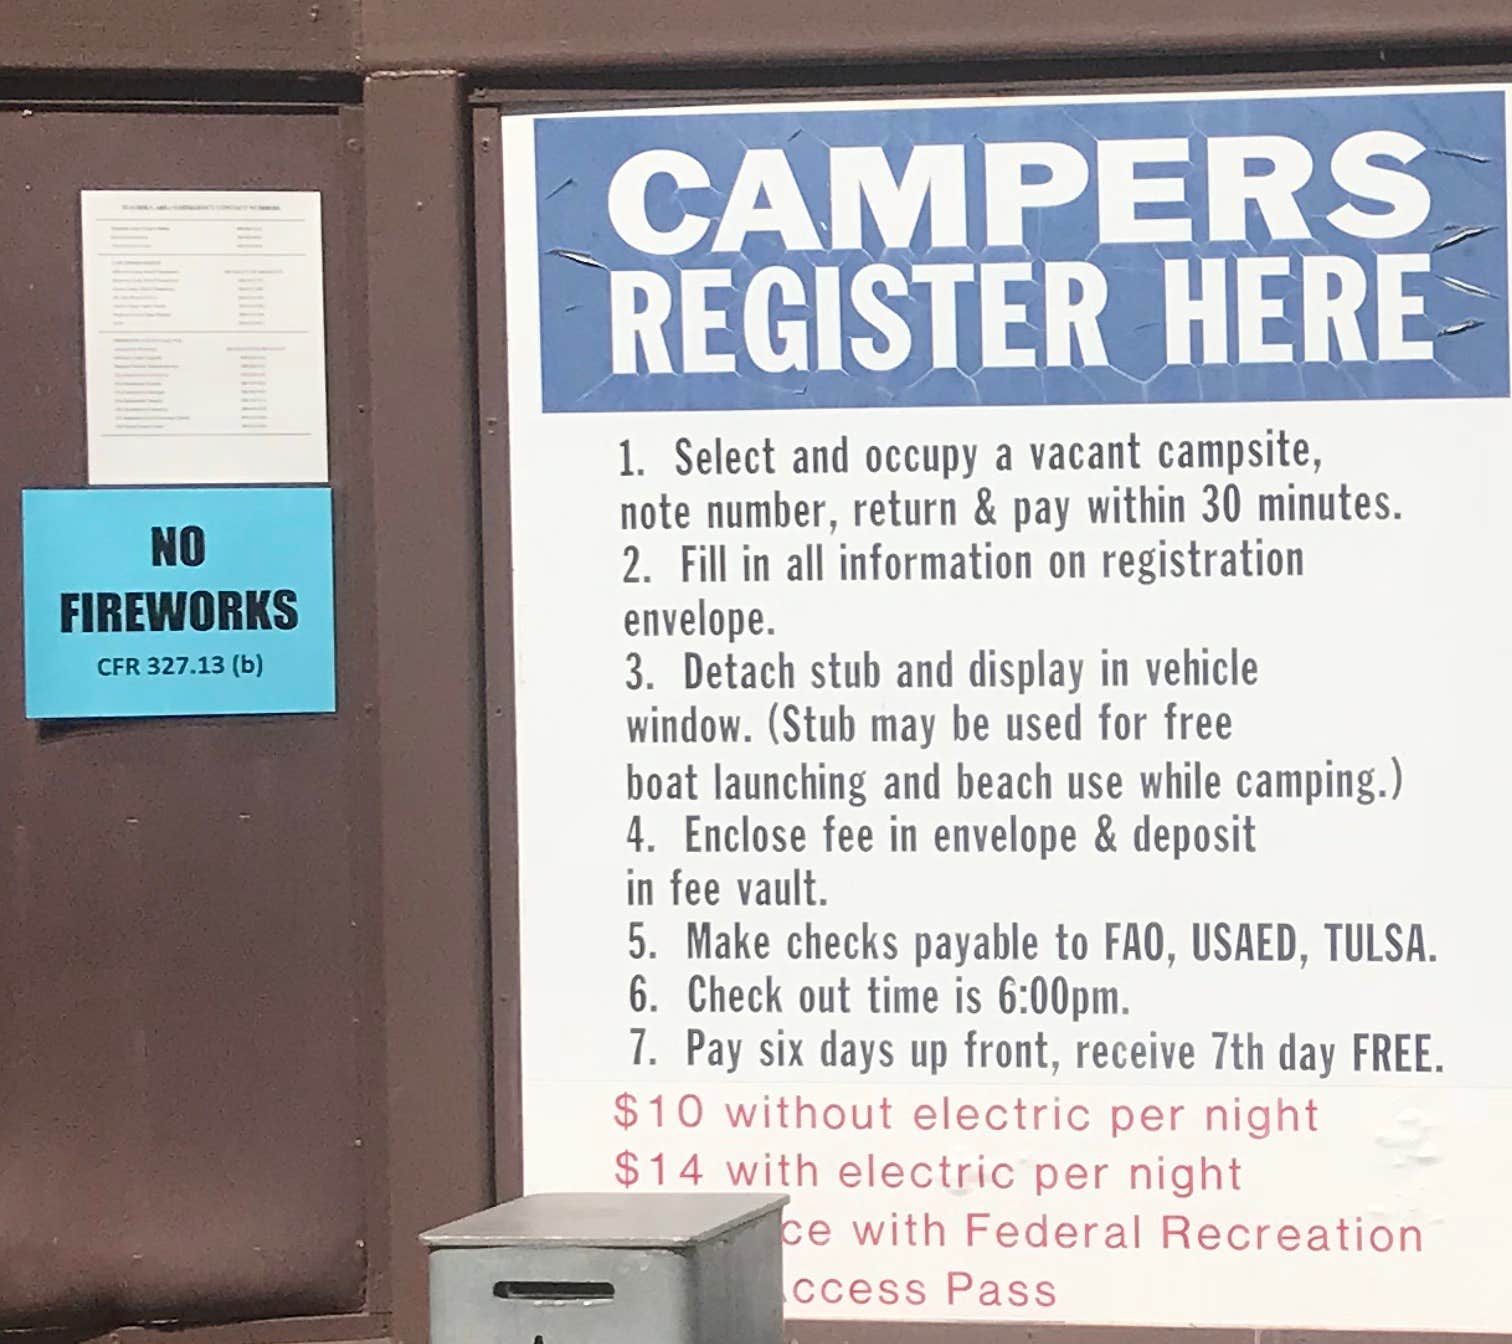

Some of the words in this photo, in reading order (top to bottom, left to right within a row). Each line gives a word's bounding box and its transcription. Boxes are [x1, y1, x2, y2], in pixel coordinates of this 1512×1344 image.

[607, 130, 1431, 256] CAMPERS
[610, 261, 1110, 375] REGISTER
[1164, 253, 1434, 365] HERE
[619, 438, 645, 477] 1.
[675, 436, 776, 477] Select
[792, 434, 849, 475] and
[865, 444, 978, 480] occupy
[995, 443, 1013, 472] a
[1029, 432, 1141, 471] vacant
[1158, 428, 1322, 476] campsite,
[620, 492, 691, 530] note
[707, 489, 838, 535] number,
[854, 489, 957, 527] return
[973, 486, 997, 526] &
[1014, 496, 1070, 533] pay
[1087, 484, 1185, 524] within
[1201, 482, 1241, 524] 30
[1258, 482, 1402, 522] minutes.
[151, 525, 206, 567] NO
[622, 544, 651, 584] 2.
[681, 544, 727, 583] Fill
[742, 543, 770, 582] in
[786, 543, 824, 582] all
[839, 541, 1032, 581] information
[1049, 550, 1086, 579] on
[1102, 537, 1304, 586] registration
[60, 589, 298, 633] FIREWORKS
[623, 597, 775, 644] envelope.
[97, 657, 141, 677] CFR
[147, 655, 225, 676] 327.13
[232, 653, 263, 678] (b)
[625, 651, 654, 691] 3.
[684, 650, 795, 690] Detach
[811, 650, 881, 689] stub
[896, 649, 953, 689] and
[969, 648, 1084, 695] display
[1101, 648, 1129, 687] in
[1145, 646, 1258, 687] vehicle
[626, 704, 752, 744] window.
[768, 701, 856, 745] (Stub
[871, 714, 936, 750] may
[953, 703, 990, 742] be
[1006, 702, 1082, 742] used
[1098, 702, 1148, 741] for
[1163, 701, 1232, 741] free
[626, 762, 699, 801] boat
[714, 761, 867, 808] launching
[883, 761, 941, 800] and
[957, 761, 1052, 800] beach
[1067, 771, 1123, 800] use
[1139, 760, 1221, 800] while
[1236, 755, 1403, 806] camping.)
[626, 814, 655, 853] 4.
[685, 814, 807, 853] Enclose
[822, 814, 874, 853] fee
[890, 814, 917, 853] in
[934, 814, 1077, 861] envelope
[1094, 813, 1118, 853] &
[1133, 813, 1257, 861] deposit
[627, 867, 654, 906] in
[669, 867, 720, 907] fee
[736, 867, 827, 907] vault.
[628, 921, 657, 960] 5.
[687, 921, 770, 960] Make
[787, 921, 898, 961] checks
[915, 921, 1038, 968] payable
[1055, 923, 1088, 961] to
[1105, 921, 1176, 969] FAO,
[1192, 921, 1308, 970] USAED,
[1323, 922, 1437, 963] TULSA.
[629, 973, 658, 1013] 6.
[688, 974, 783, 1013] Check
[799, 976, 851, 1014] out
[867, 975, 939, 1014] time
[955, 975, 982, 1014] is
[998, 975, 1129, 1023] 6:00pm.
[629, 1027, 657, 1066] 7.
[687, 1028, 743, 1074] Pay
[759, 1028, 804, 1067] six
[820, 1028, 894, 1075] days
[911, 1039, 948, 1076] up
[963, 1029, 1060, 1077] front,
[1076, 1030, 1195, 1070] receive
[1211, 1031, 1264, 1071] 7th
[1279, 1032, 1336, 1080] day
[1353, 1032, 1444, 1073] FREE.
[613, 1091, 703, 1131] $10
[725, 1095, 892, 1130] without
[913, 1095, 1090, 1132] electric
[1111, 1104, 1185, 1139] per
[1206, 1097, 1318, 1140] night
[615, 1149, 704, 1188] $14
[726, 1152, 818, 1187] with
[839, 1153, 1014, 1190] electric
[1035, 1163, 1109, 1197] per
[1130, 1155, 1242, 1199] night
[852, 1212, 945, 1247] with
[966, 1212, 1140, 1249] Federal
[1162, 1214, 1422, 1253] Recreation
[783, 1278, 926, 1306] ccess
[947, 1271, 1056, 1307] Pass
